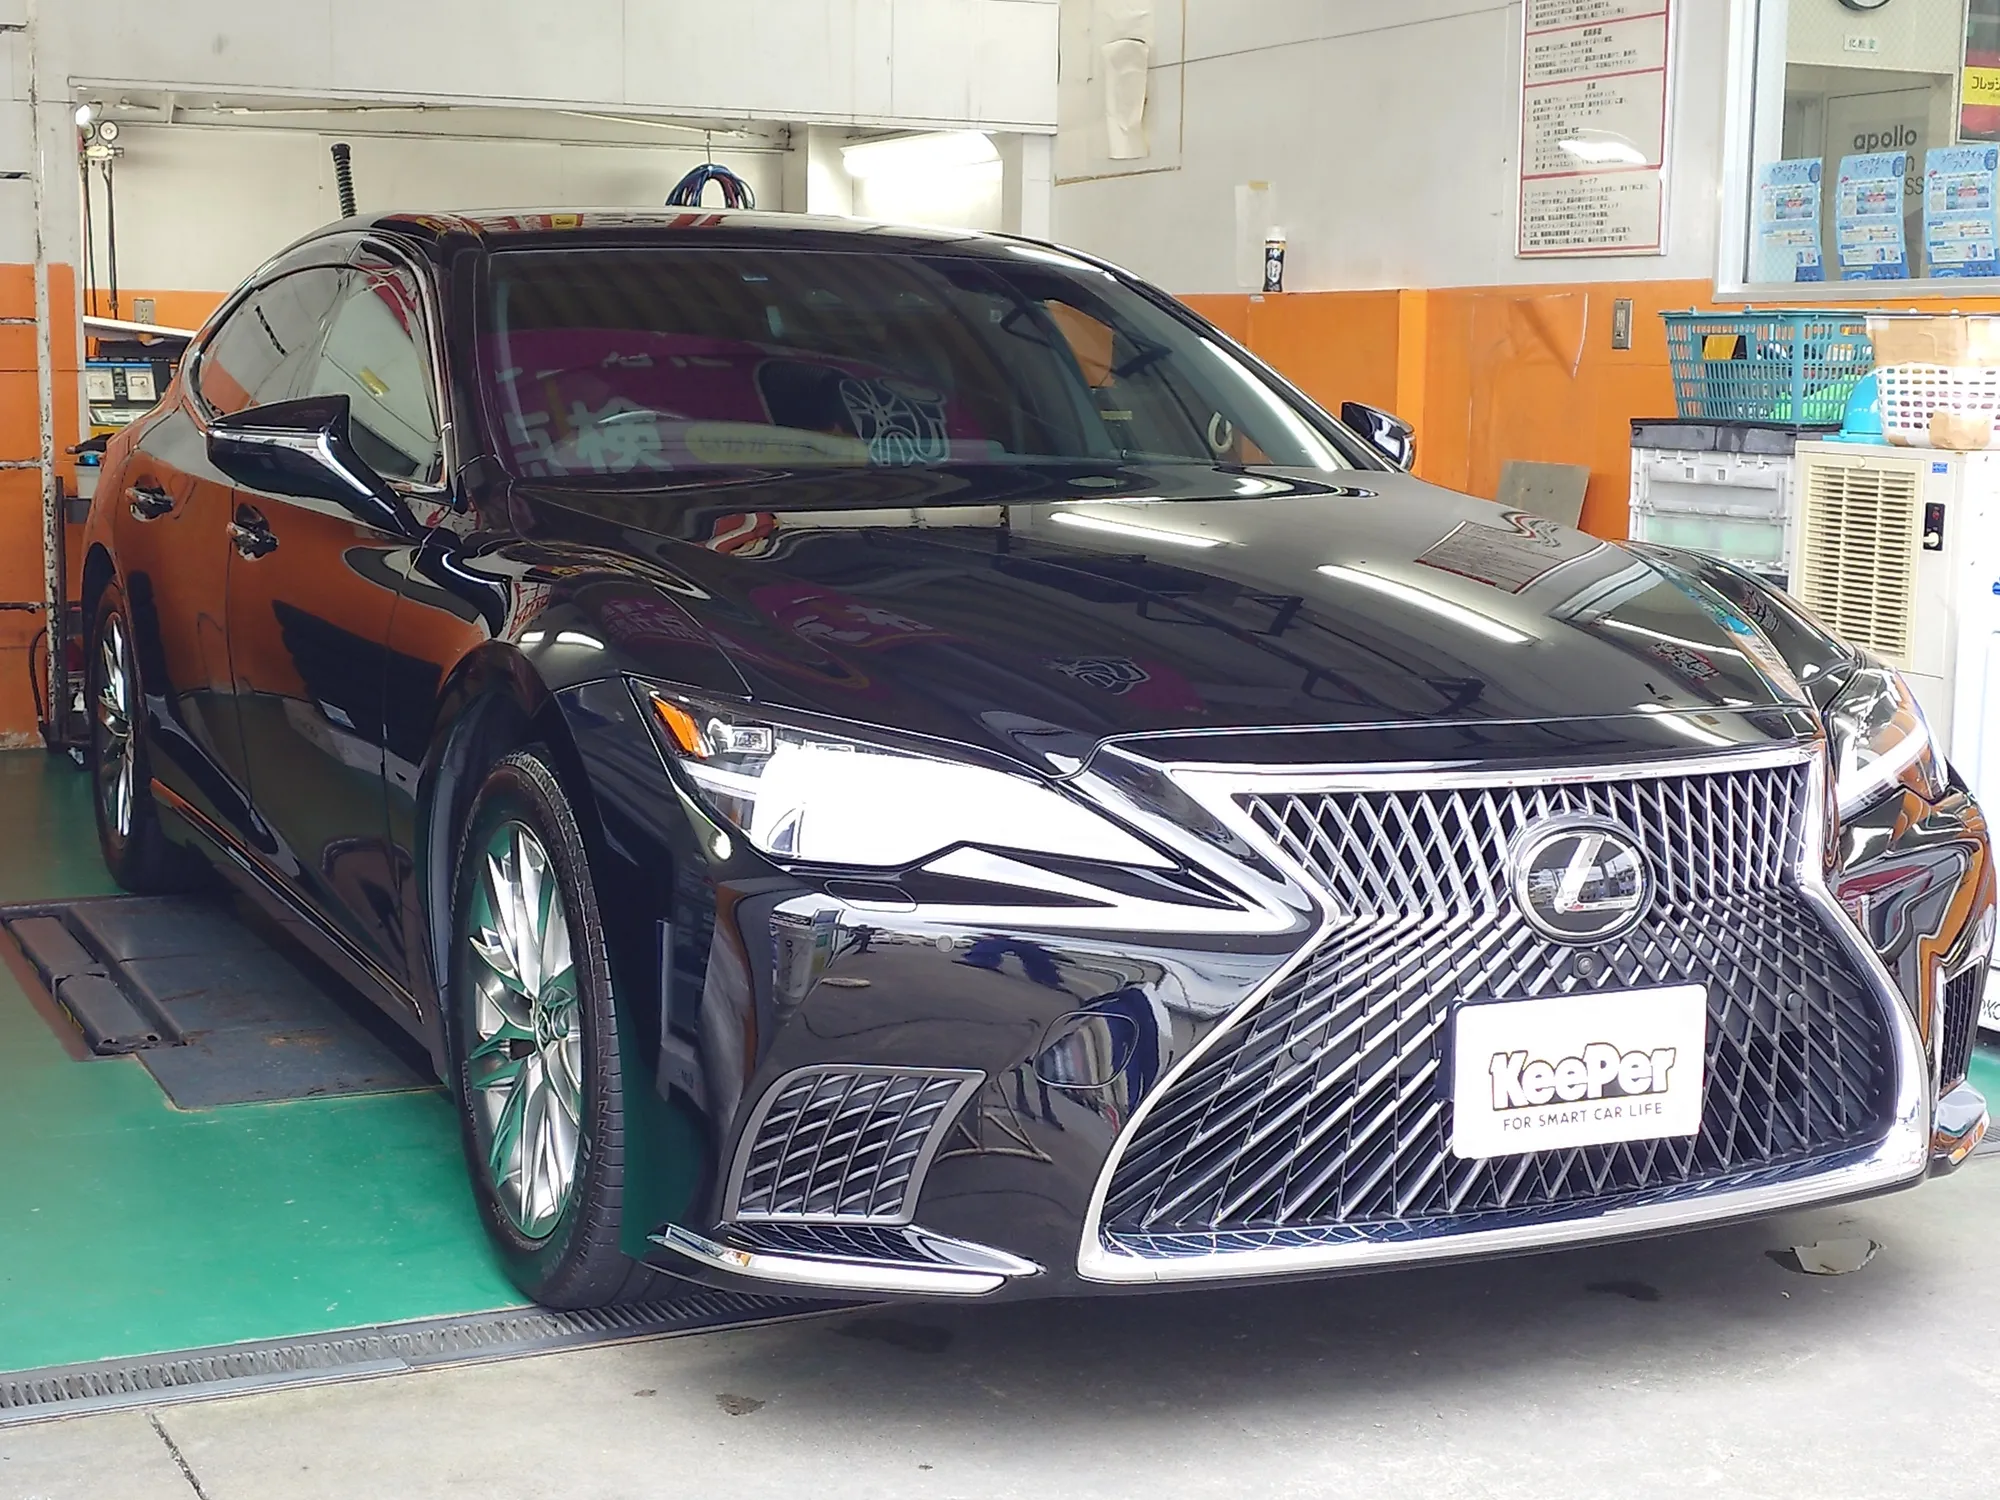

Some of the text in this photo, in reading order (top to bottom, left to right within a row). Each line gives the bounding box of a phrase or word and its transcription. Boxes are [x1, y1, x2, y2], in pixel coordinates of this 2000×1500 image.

[1854, 124, 1917, 154] apollo
[1488, 1042, 1677, 1111] KeePer
[1503, 1102, 1663, 1131] FOR SMART CAR LIFE
